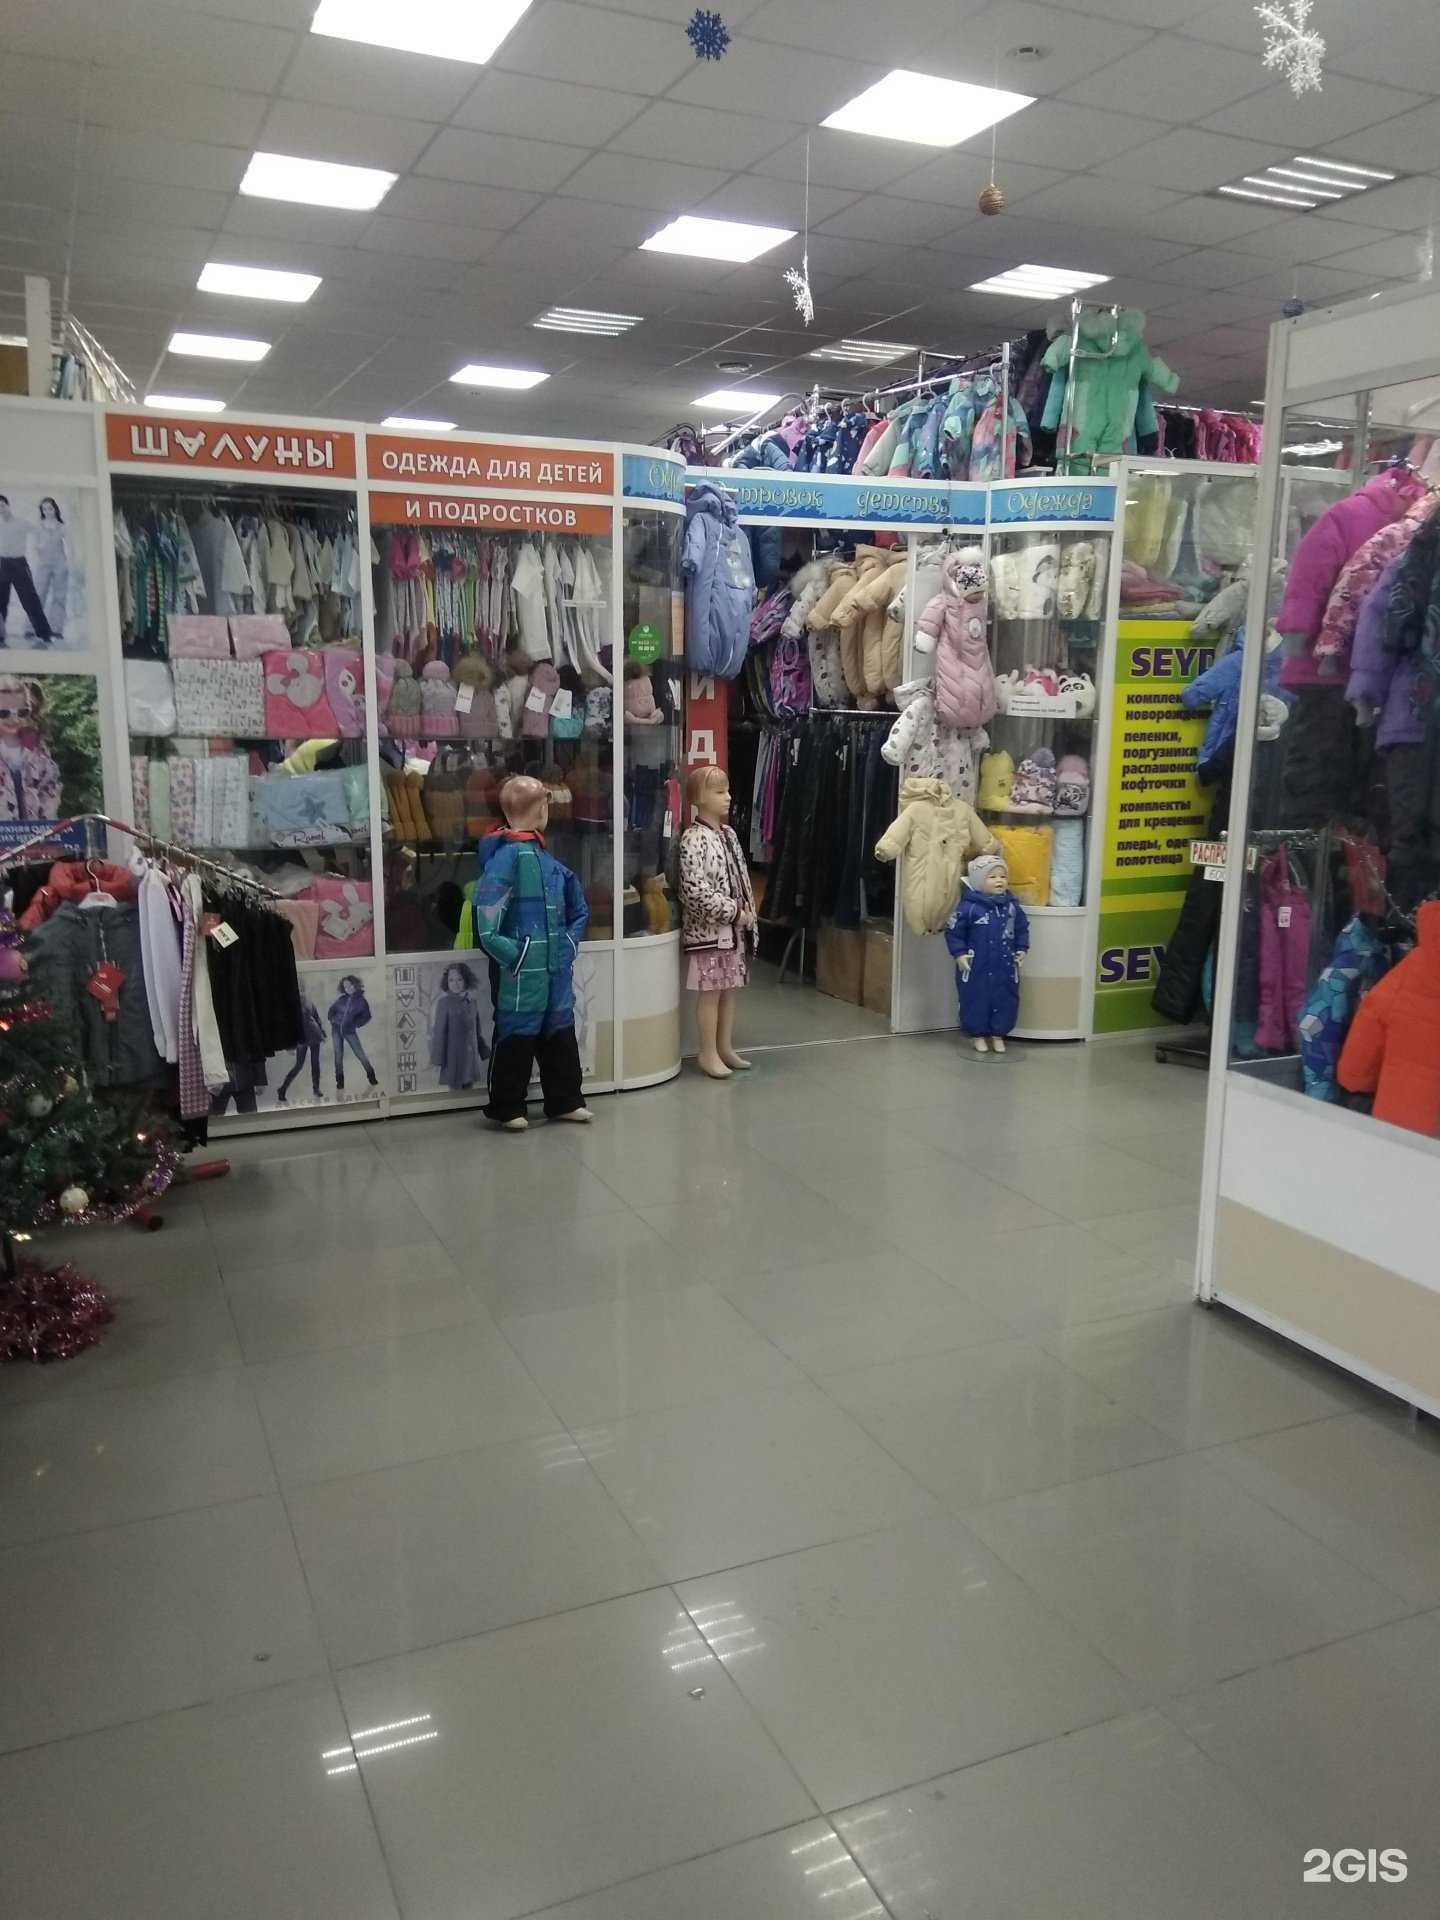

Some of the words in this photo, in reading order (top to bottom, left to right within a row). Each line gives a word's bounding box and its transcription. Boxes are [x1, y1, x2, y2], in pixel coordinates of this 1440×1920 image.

[130, 424, 334, 470] ШАЛУНЫ
[382, 450, 482, 479] ОДЕЖДА
[486, 458, 532, 481] ДЛЯ
[537, 462, 603, 485] ДЕТЕЙ
[724, 484, 824, 509] тровок
[1007, 490, 1093, 519] Одежда
[405, 499, 421, 519] И
[428, 501, 577, 527] ПОДРОСТКОВ
[1121, 777, 1186, 793] кофточки
[1120, 801, 1191, 812] комплекты
[1118, 818, 1140, 829] для
[1116, 853, 1183, 867] полотенца
